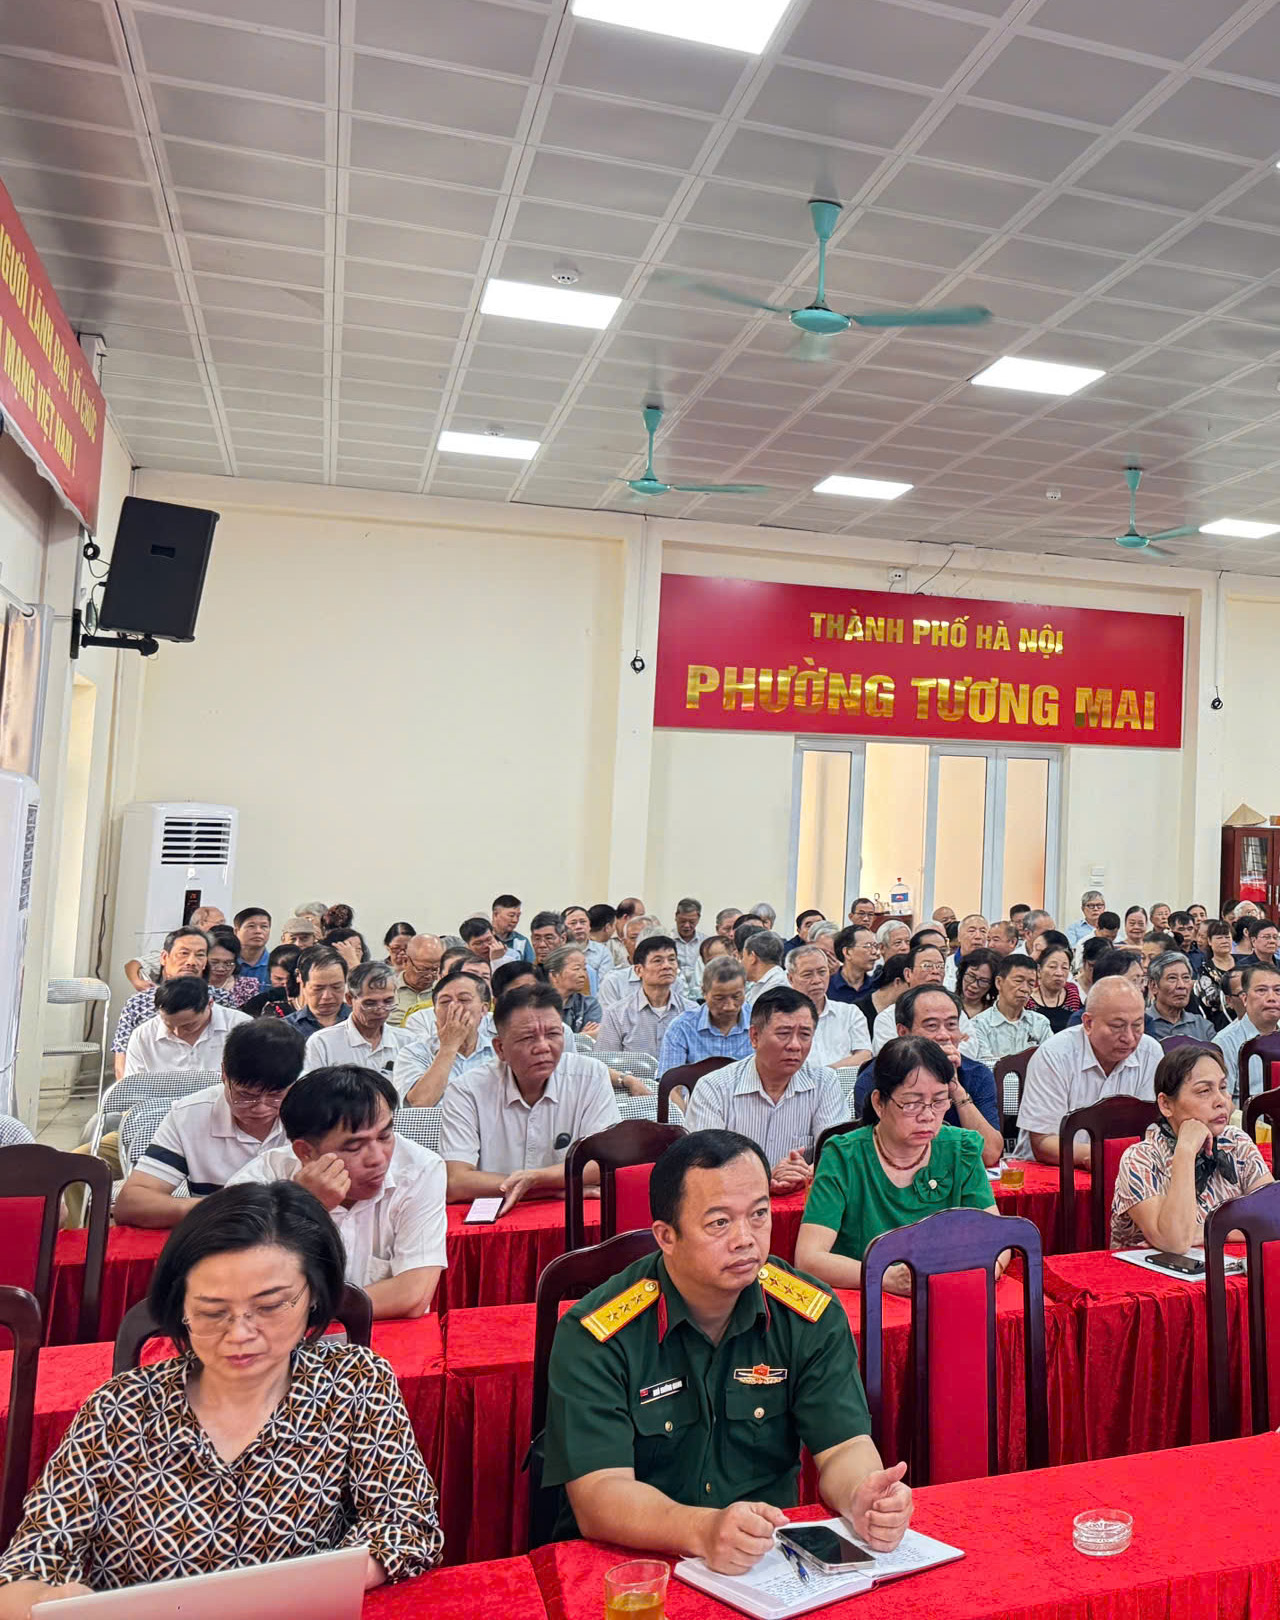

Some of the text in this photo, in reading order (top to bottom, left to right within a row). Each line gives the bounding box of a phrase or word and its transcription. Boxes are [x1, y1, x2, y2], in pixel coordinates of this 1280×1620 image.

[28, 284, 54, 363] LÃNH
[4, 326, 36, 413] MẠNG
[36, 380, 55, 443] VIỆT
[54, 411, 73, 470] NAM
[810, 608, 1064, 659] THÀNH PHỐ HÀ NỘI
[686, 657, 1155, 730] PHƯỜNG TƯƠNG MAI
